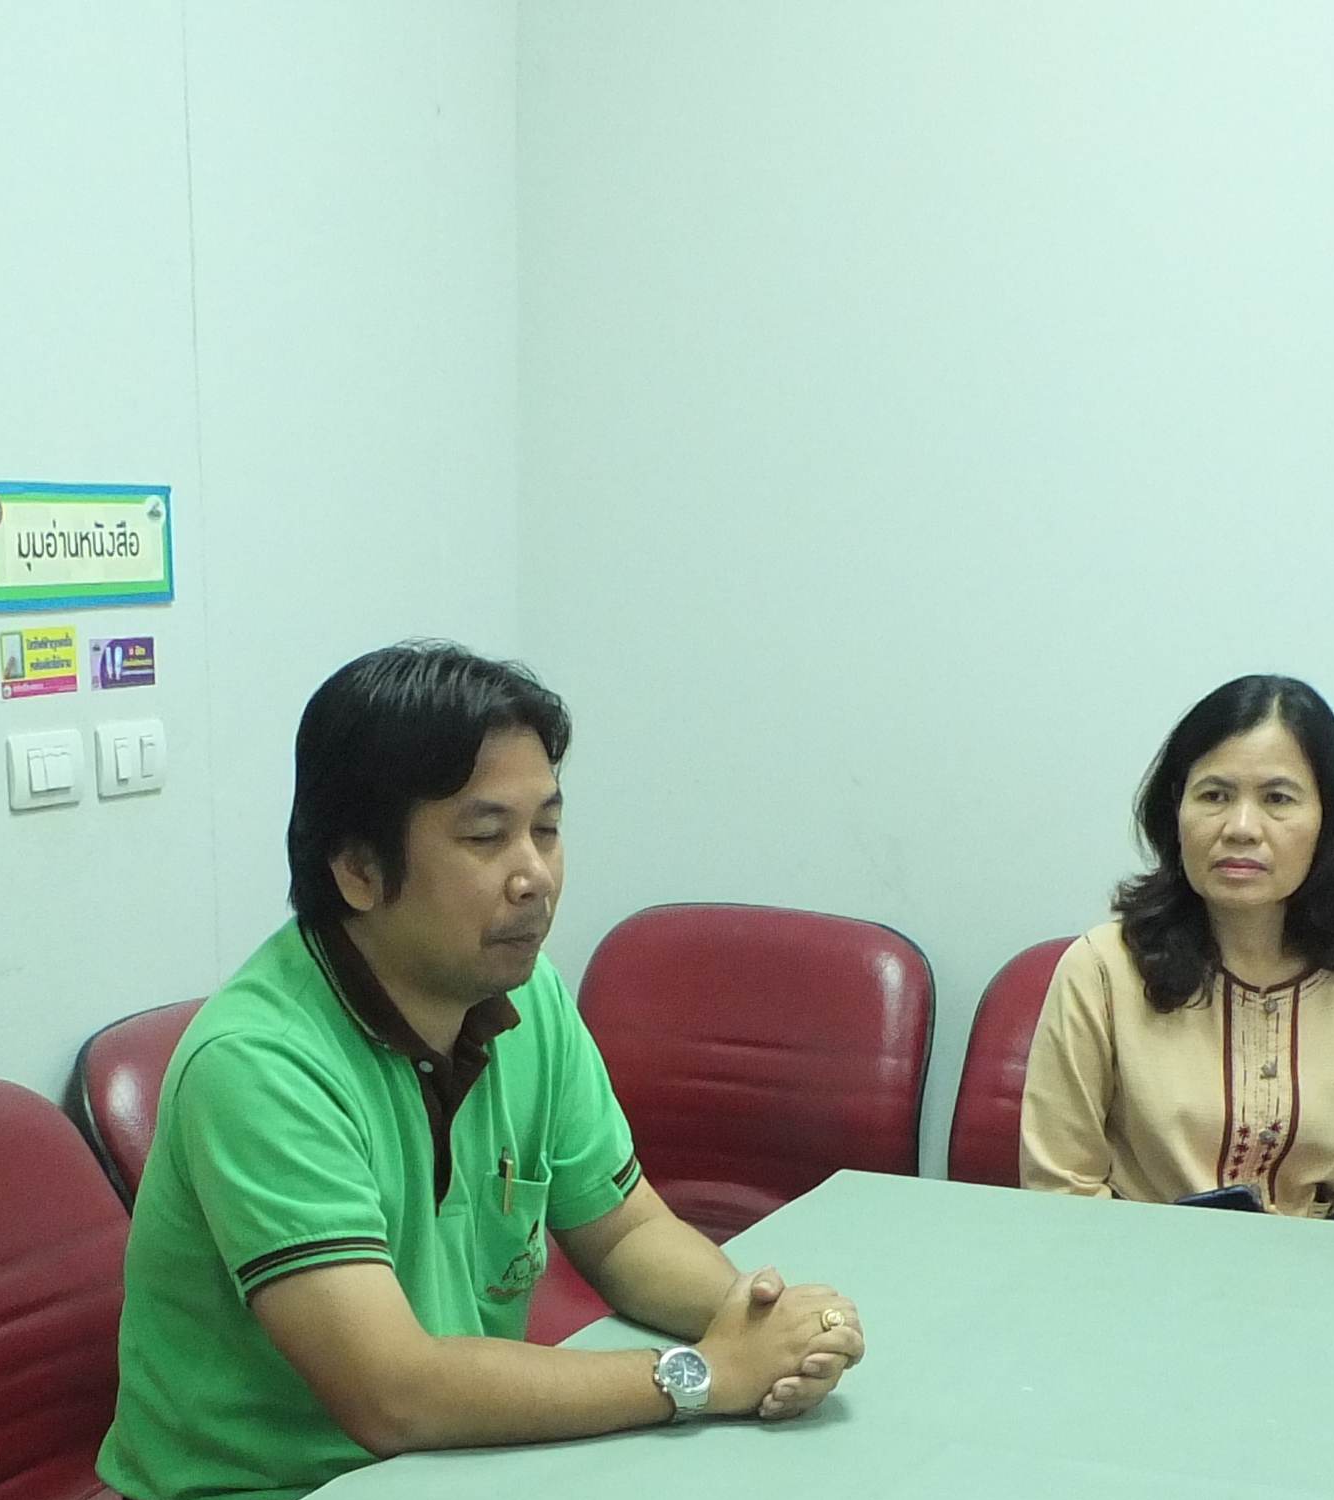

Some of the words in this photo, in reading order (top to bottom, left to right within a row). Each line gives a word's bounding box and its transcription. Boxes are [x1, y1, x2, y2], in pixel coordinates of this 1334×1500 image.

[17, 519, 141, 572] มุมอ่านหนังสือ
